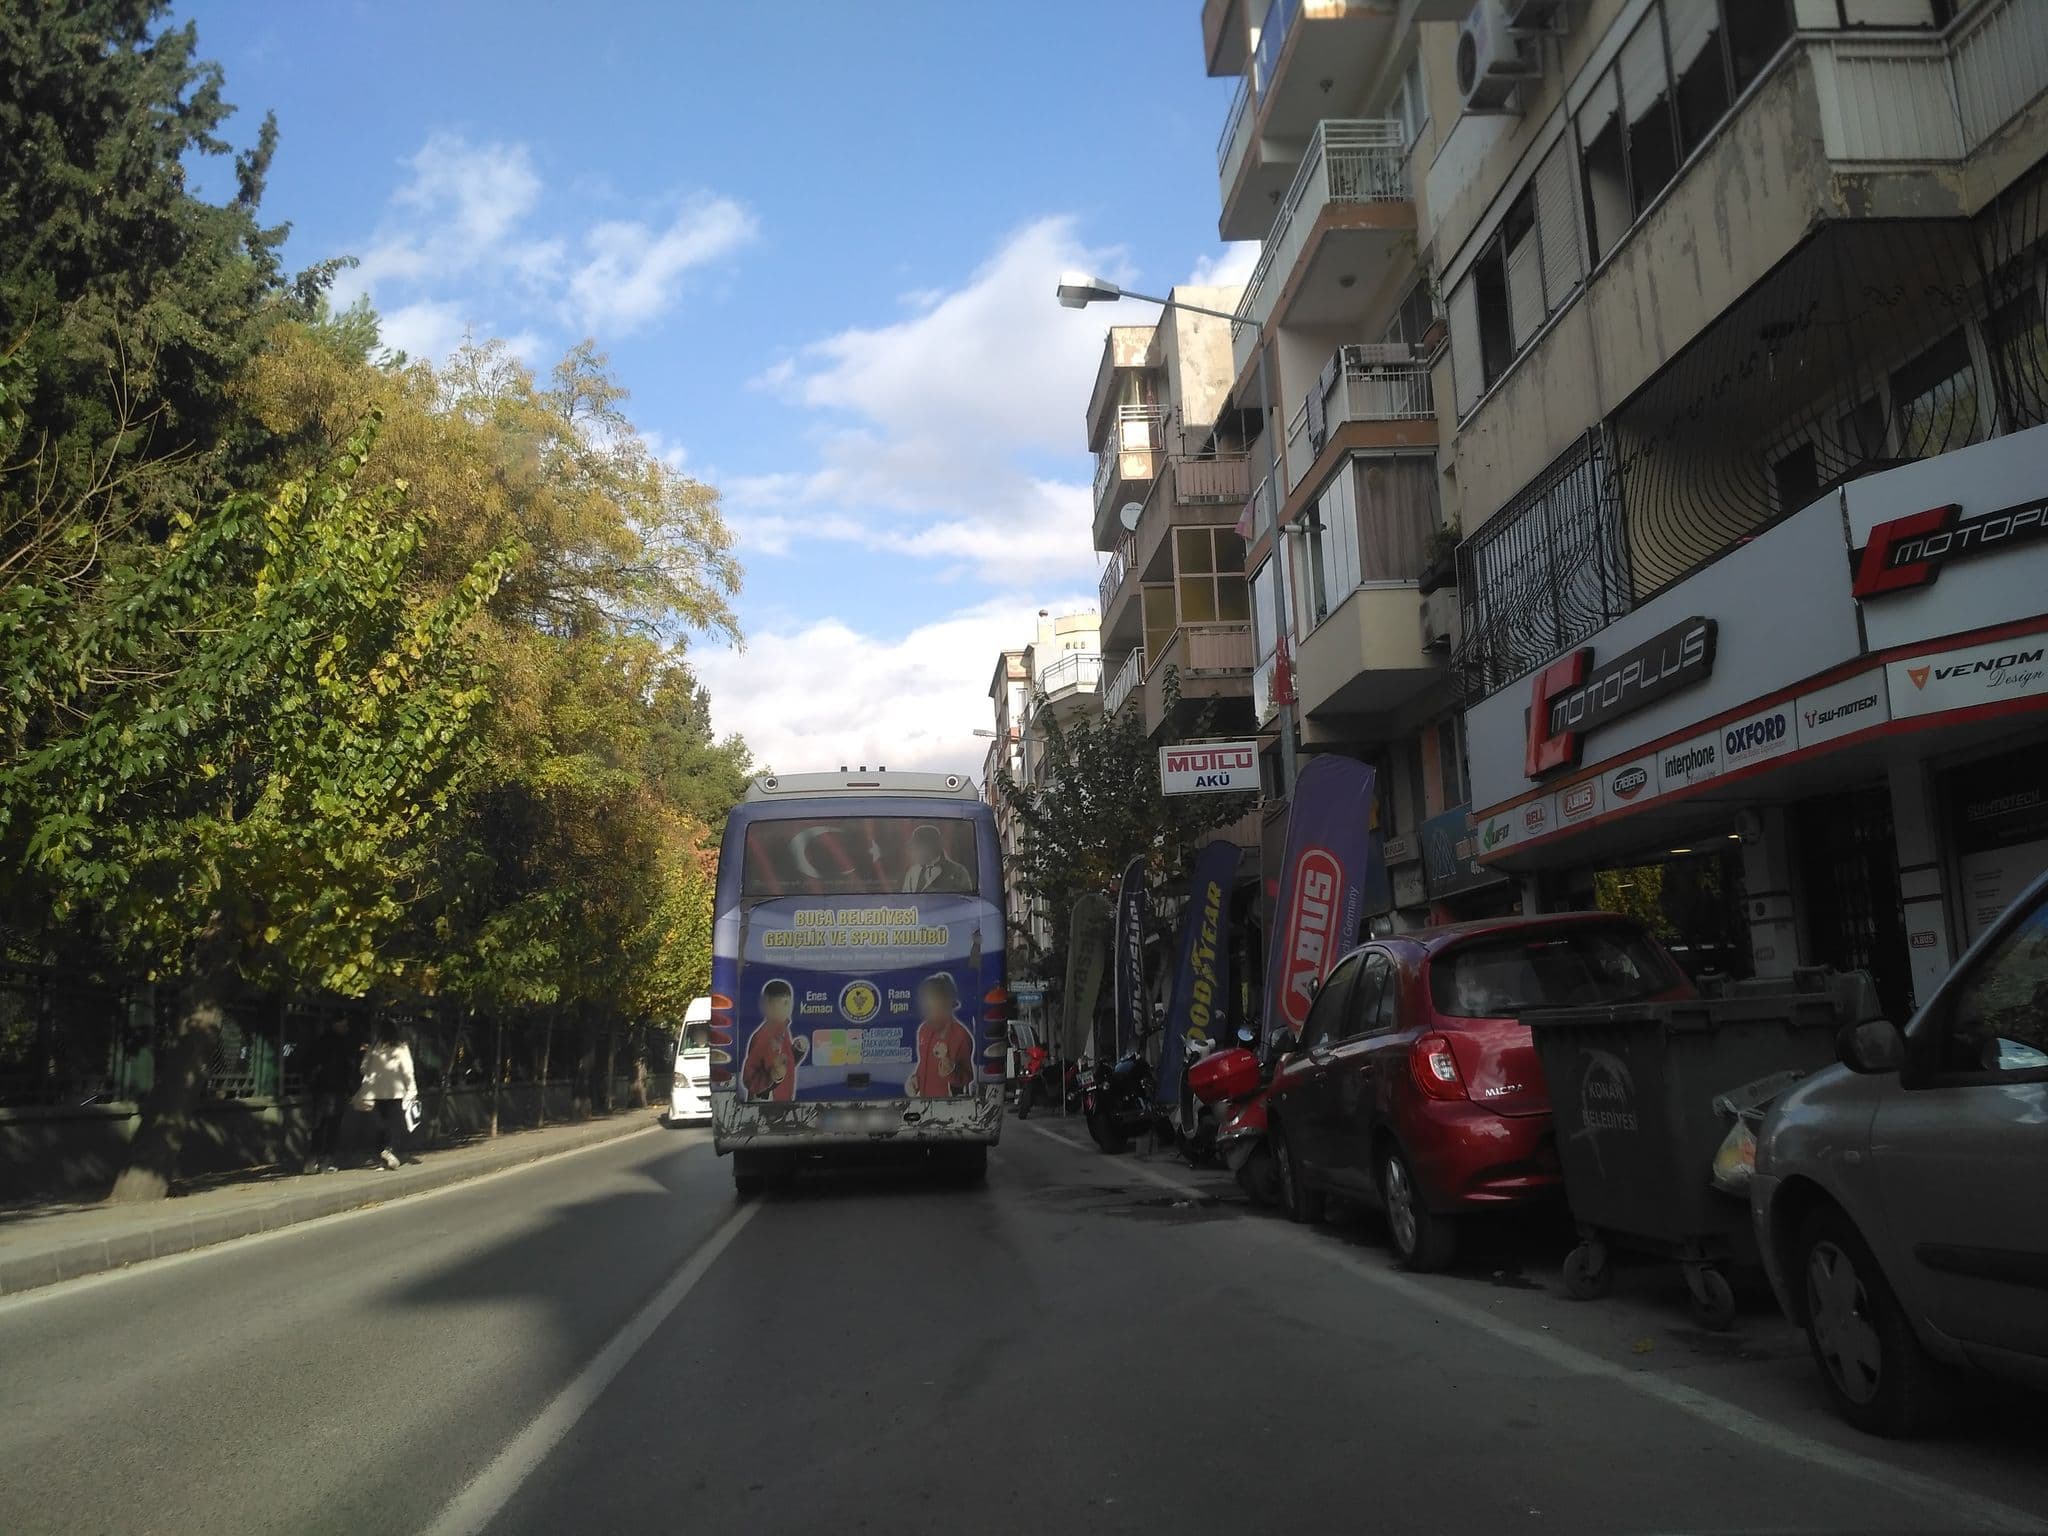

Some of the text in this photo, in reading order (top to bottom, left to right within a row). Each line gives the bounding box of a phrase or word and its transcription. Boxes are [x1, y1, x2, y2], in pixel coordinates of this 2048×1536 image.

[1934, 648, 2045, 680] VENOM
[1551, 625, 1706, 733] MOTOPLUS
[1986, 668, 2045, 689] Design
[1817, 694, 1878, 725] SW-MOTECH
[1725, 713, 1787, 756] OXFORD
[1167, 747, 1254, 773] MUTLU
[1664, 744, 1716, 779] interphone
[1195, 771, 1230, 788] AKÜ
[1525, 810, 1545, 827] BELL
[795, 907, 918, 926] BUCA BELEDİYESİ
[1343, 885, 1361, 936] Germany
[764, 927, 948, 948] GENÇLİK VE SPOR KULÜBÜ
[1290, 868, 1333, 1003] ABUS
[1185, 880, 1223, 1041] OODYEAR
[805, 990, 828, 1002] Enes
[887, 988, 911, 1000] Rana
[1589, 1081, 1625, 1099] KONAK
